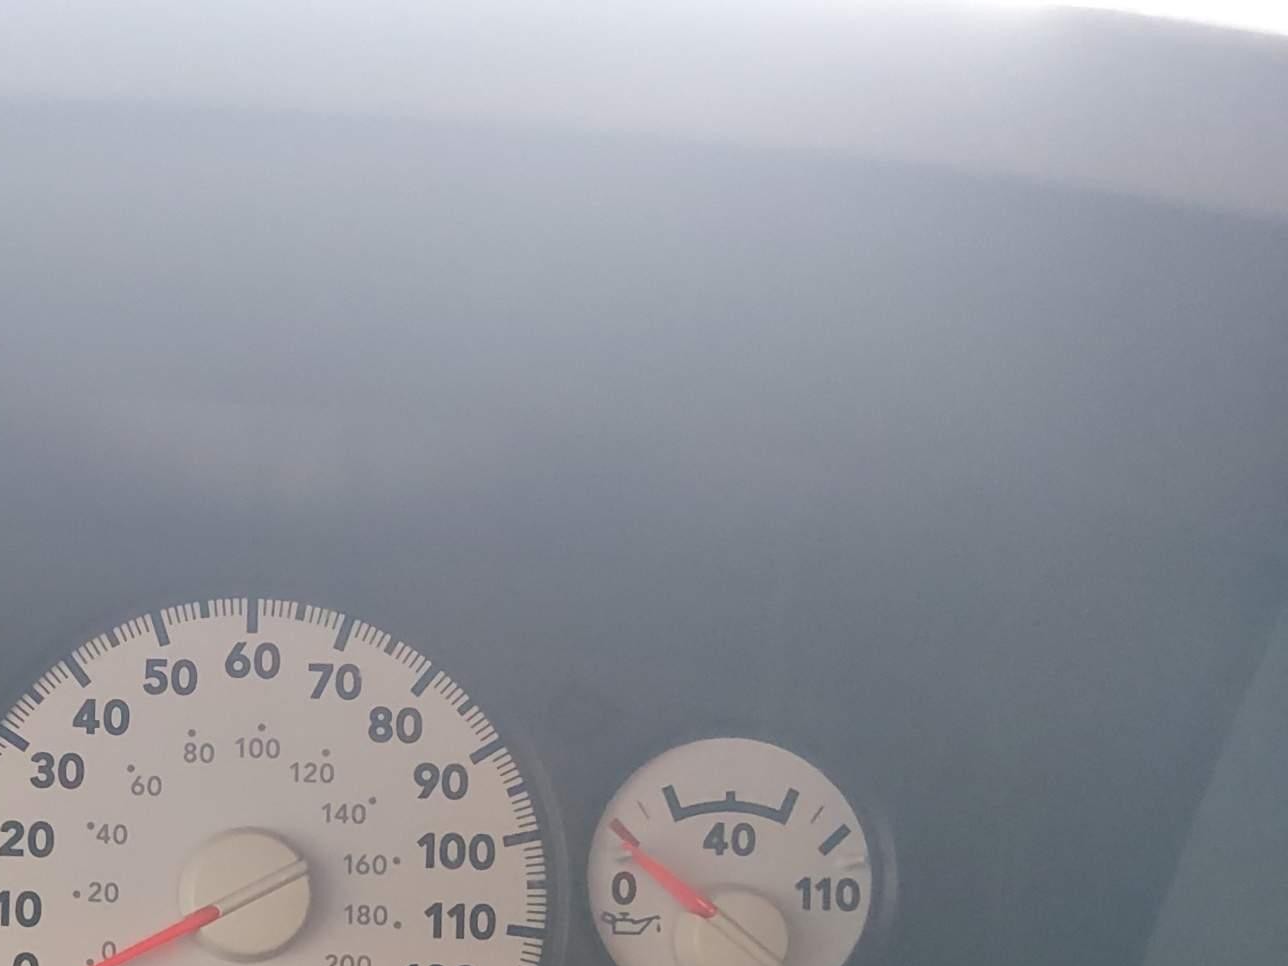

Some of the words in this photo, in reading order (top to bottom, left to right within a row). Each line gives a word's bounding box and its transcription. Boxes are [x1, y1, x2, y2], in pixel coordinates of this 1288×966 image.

[143, 658, 198, 696] 50
[224, 642, 280, 680] 60
[308, 662, 362, 701] 70
[72, 698, 130, 736] 40
[367, 706, 423, 744] 80
[183, 743, 215, 765] 80
[234, 738, 280, 760] 100
[29, 752, 85, 789] 30
[130, 775, 162, 796] 60
[290, 763, 335, 785] 120
[413, 762, 469, 800] 90
[321, 803, 367, 825] 140
[95, 824, 128, 846] 40
[416, 832, 496, 871] 100
[702, 822, 756, 857] 40
[343, 854, 388, 876] 160
[87, 882, 119, 904] 20
[611, 871, 637, 906] 0
[794, 877, 861, 913] 110
[343, 905, 389, 926] 180
[424, 902, 496, 940] 110
